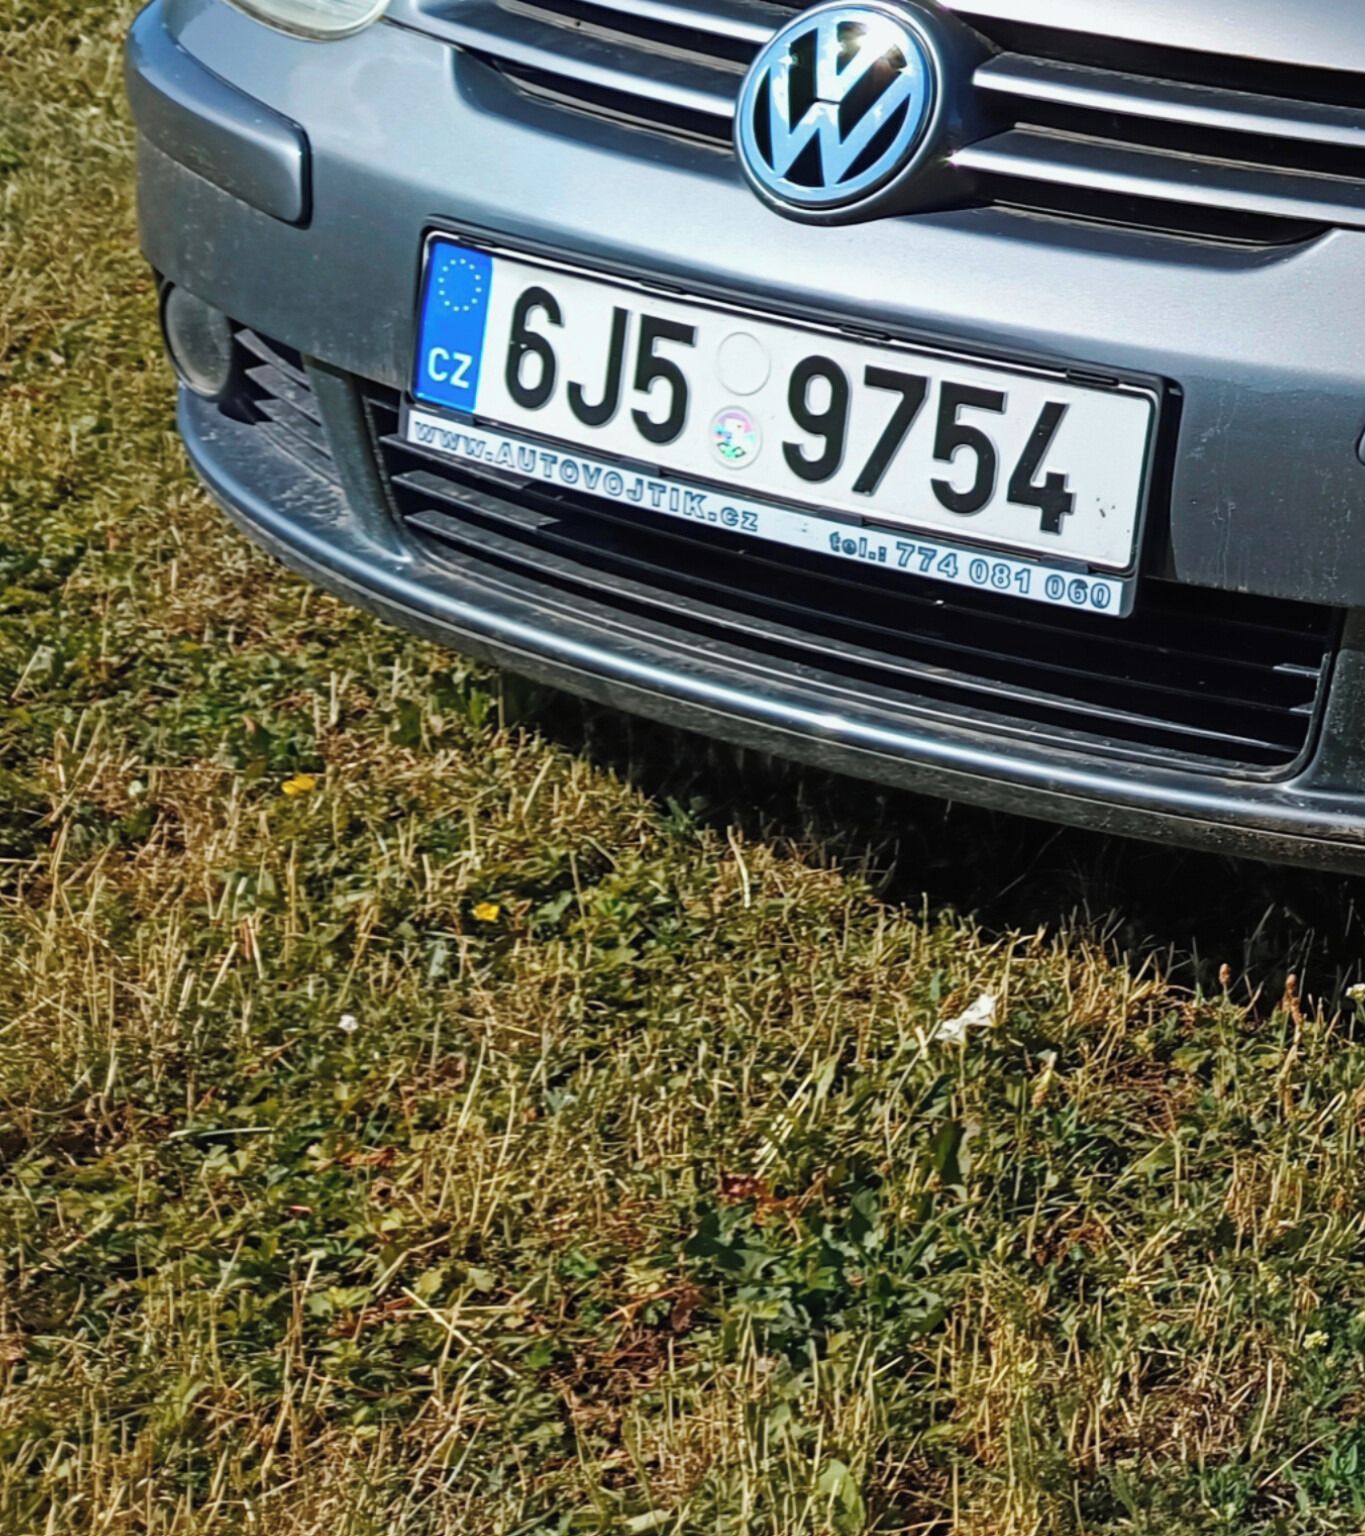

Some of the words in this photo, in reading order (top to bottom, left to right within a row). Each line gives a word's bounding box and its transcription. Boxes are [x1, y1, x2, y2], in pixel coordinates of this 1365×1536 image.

[740, 1, 931, 202] VW
[427, 346, 473, 389] CZ
[504, 285, 698, 445] 6J5
[781, 354, 1076, 535] 9754
[895, 541, 959, 579] 774
[968, 558, 1031, 595] 081
[1044, 574, 1112, 609] 060
